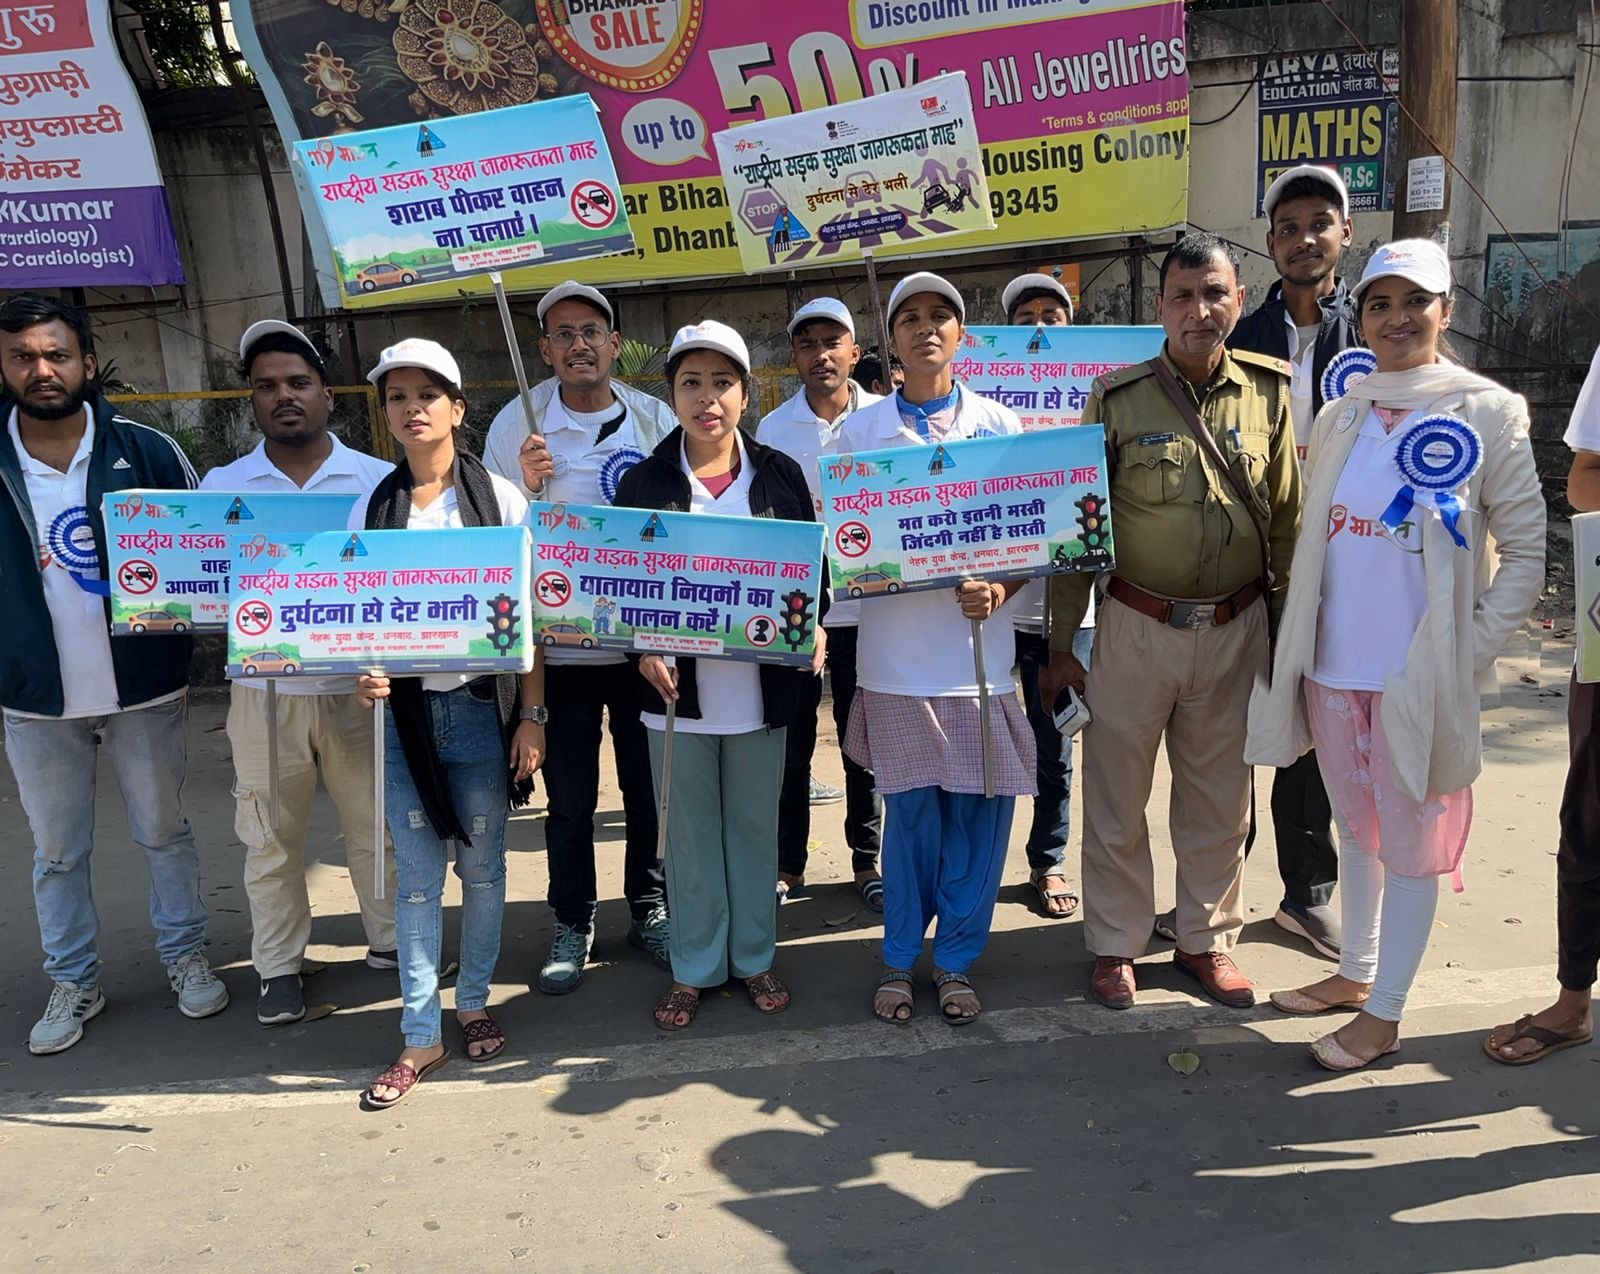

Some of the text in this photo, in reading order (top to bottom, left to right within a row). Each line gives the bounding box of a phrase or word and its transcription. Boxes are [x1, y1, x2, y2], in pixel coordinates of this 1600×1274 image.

[590, 7, 665, 51] SALE
[982, 55, 1023, 108] All
[1032, 33, 1187, 101] Jewellries
[1263, 81, 1340, 101] EDUCATION
[1099, 101, 1162, 122] conditions
[633, 115, 695, 149] up to
[1094, 128, 1187, 164] Colony
[1263, 105, 1382, 161] MATHS
[320, 140, 598, 204] राष्ट्रीय सड़क सुरक्षा जागरूकता माह
[784, 152, 819, 182] सड़क
[821, 144, 857, 179] सुरक्षा
[857, 129, 928, 160] जागरूकता
[386, 177, 566, 227] शराब पीकर वाहन
[805, 171, 909, 212] दुर्घटना से देर भली
[747, 203, 778, 218] STOP
[433, 227, 465, 249] ना
[12, 245, 134, 268] Cardiologist)
[988, 362, 1024, 380] सड़क
[1029, 362, 1066, 383] सुरक्षा
[1043, 386, 1063, 409] से
[832, 488, 883, 516] राष्ट्रीय
[888, 486, 931, 509] सड़क
[935, 480, 977, 507] सुरक्षा
[983, 470, 1065, 496] जागरूकता
[1070, 466, 1098, 485] माह
[898, 499, 1046, 531] मत करो इतनी मस्ती
[116, 528, 226, 555] राष्ट्रीय सड़क
[901, 530, 953, 551] जिंदगी
[1006, 518, 1046, 537] सस्ती
[537, 540, 811, 581] राष्ट्रीय सड़क सुरक्षा जागरूकता माह
[165, 580, 219, 594] आपना
[238, 569, 289, 596] राष्ट्रीय
[294, 572, 338, 593] सड़क
[343, 570, 387, 594] सुरक्षा
[392, 568, 477, 588] जागरूकता
[483, 567, 513, 585] माह
[580, 575, 665, 601] यातायात
[747, 588, 775, 608] का
[280, 594, 478, 632] दुर्घटना से देर भली
[620, 607, 681, 630] पालन
